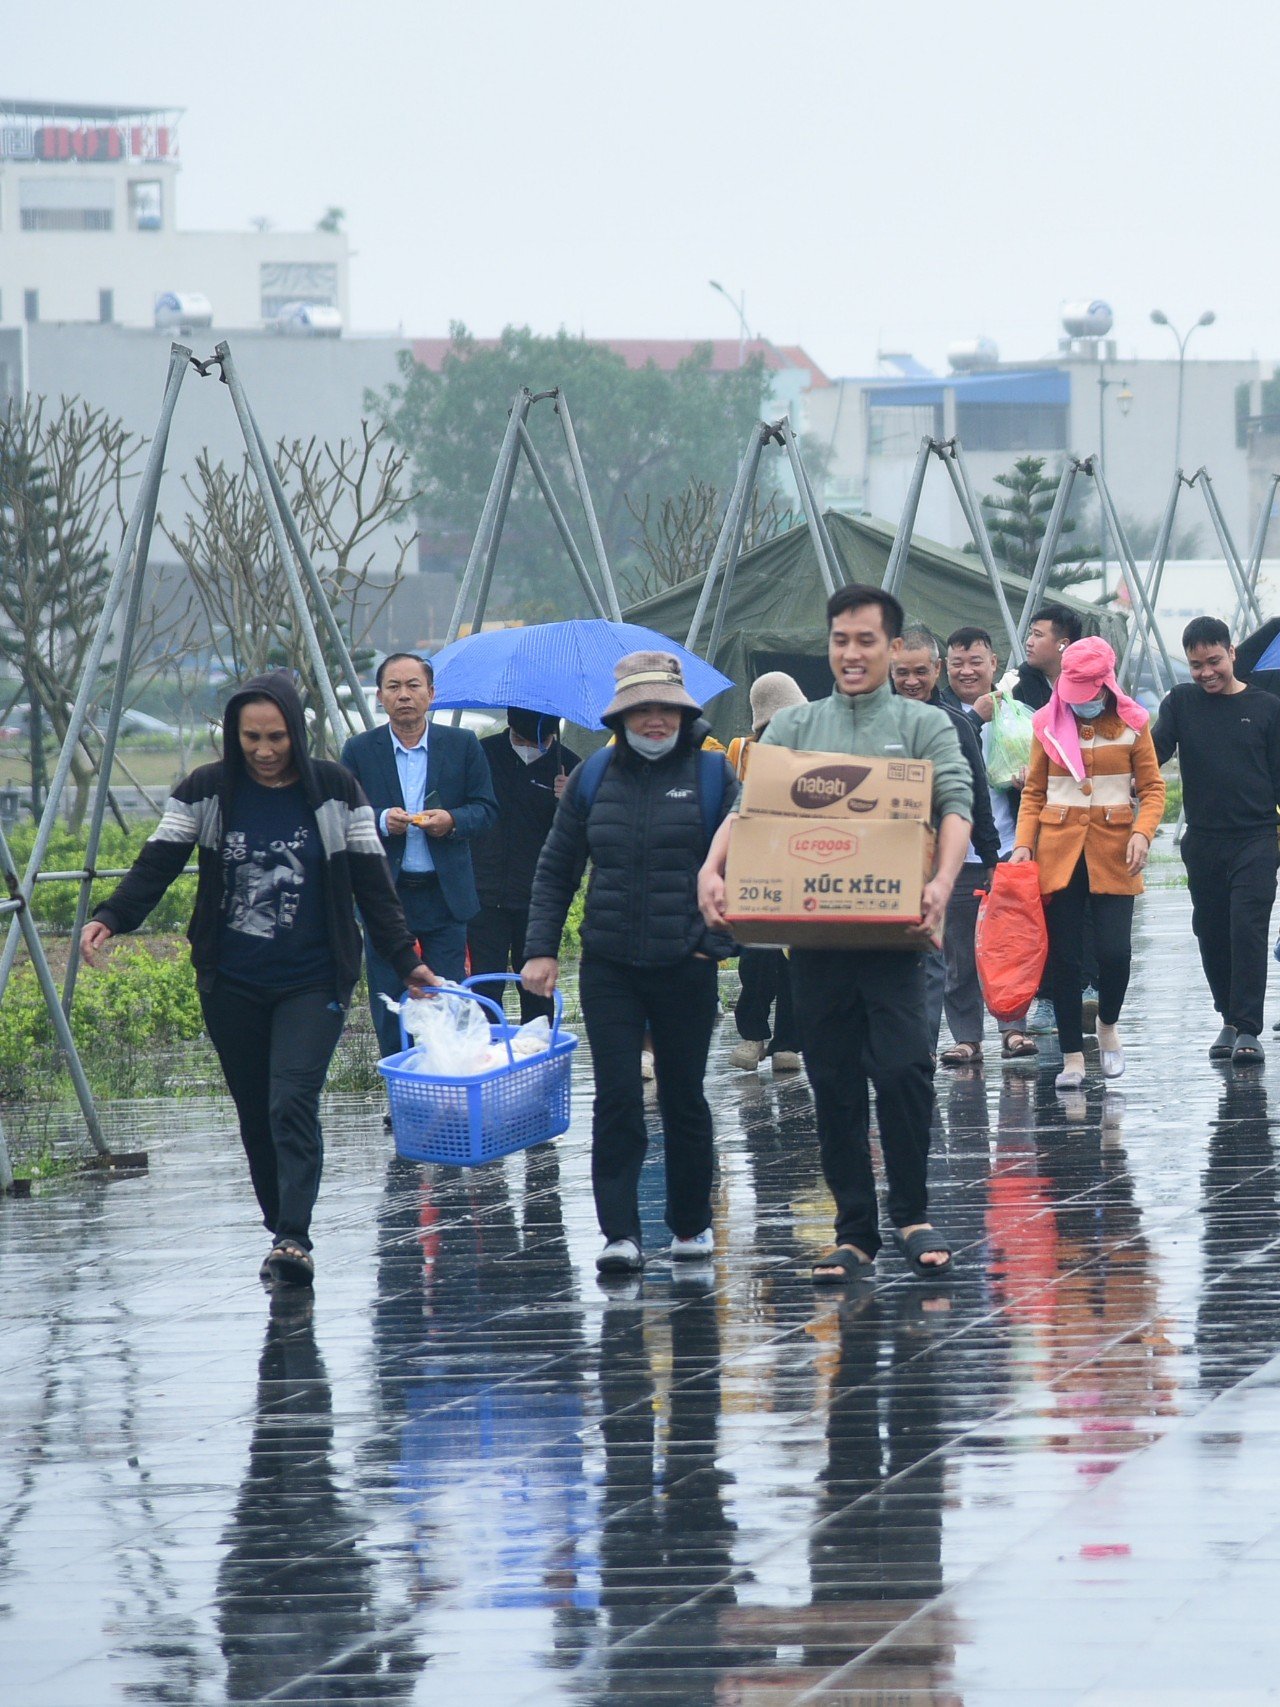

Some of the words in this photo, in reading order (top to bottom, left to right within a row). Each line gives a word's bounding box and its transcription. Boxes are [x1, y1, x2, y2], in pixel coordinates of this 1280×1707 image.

[797, 776, 846, 797] nabati
[795, 840, 810, 850] LC
[811, 840, 851, 850] FOODS
[803, 874, 843, 893] XÚC
[848, 874, 901, 894] XÍCH
[739, 887, 759, 899] 20
[763, 886, 782, 902] kg
